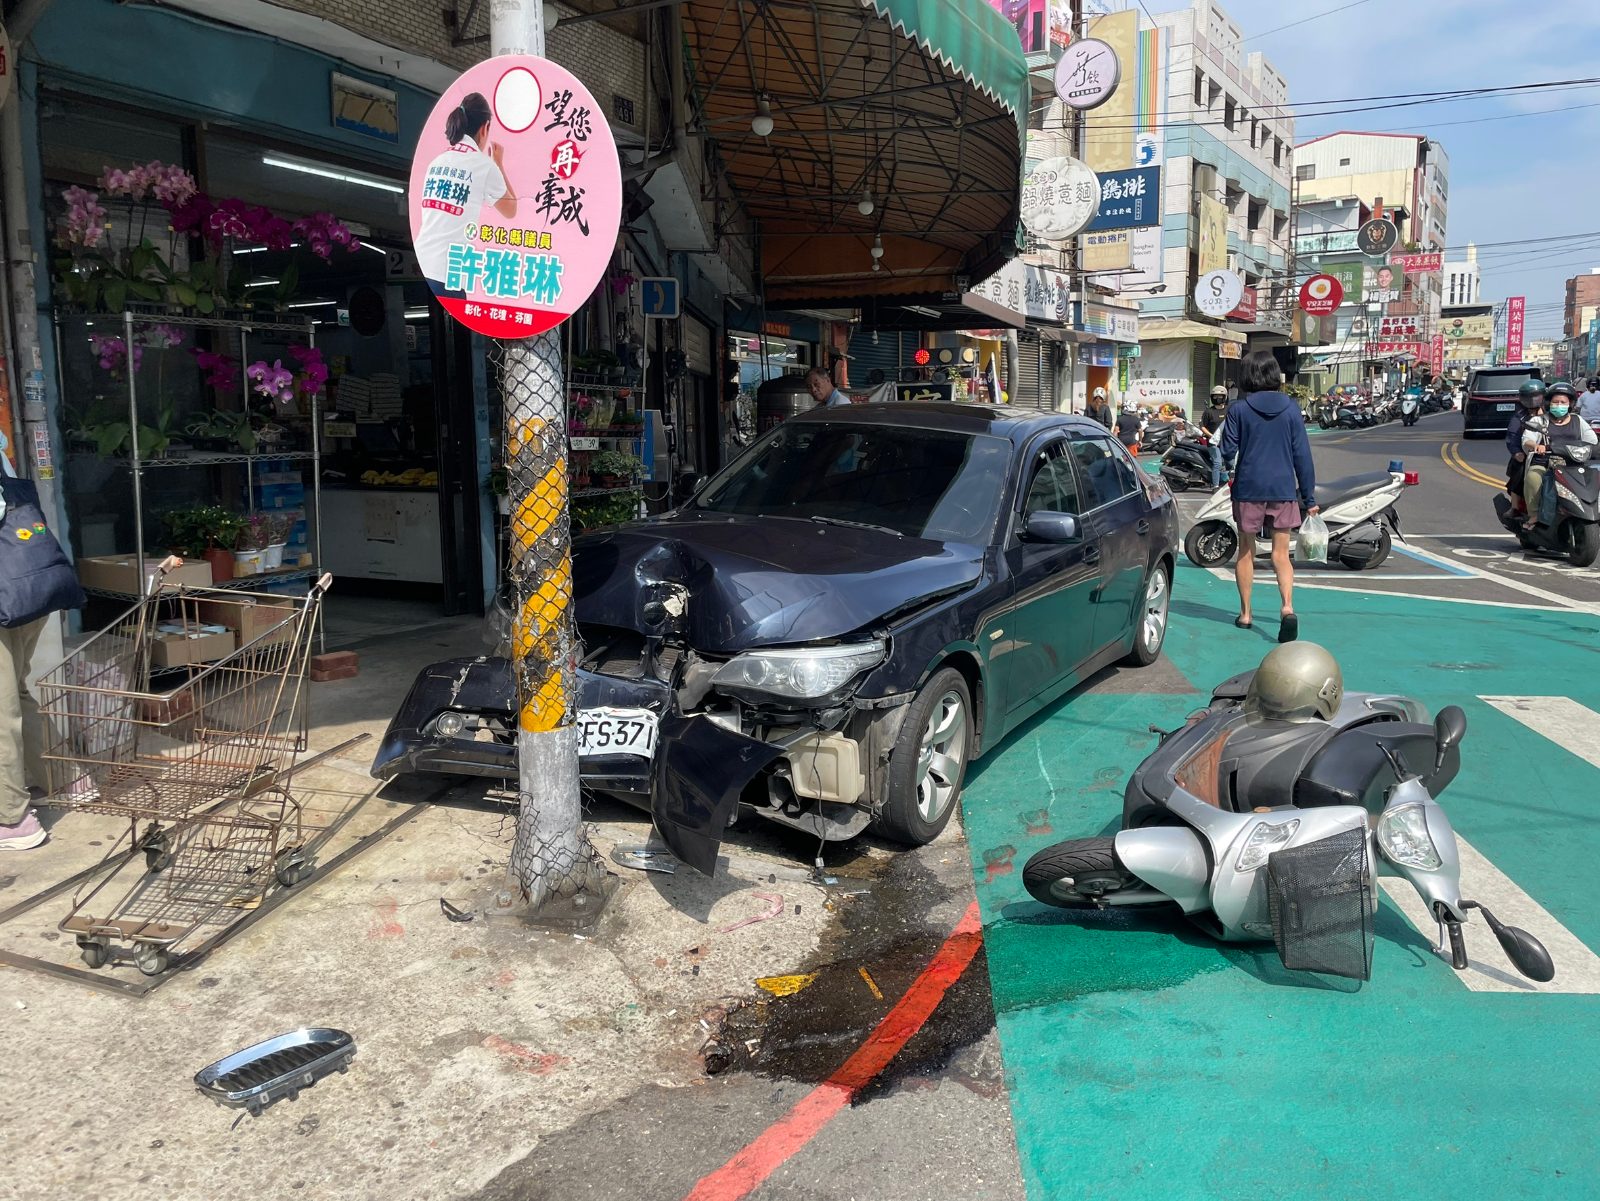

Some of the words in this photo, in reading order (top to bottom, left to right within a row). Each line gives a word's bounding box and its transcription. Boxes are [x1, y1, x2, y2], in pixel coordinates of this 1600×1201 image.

[544, 89, 592, 141] 望您
[551, 142, 580, 175] 再
[424, 178, 470, 206] 許雅琳
[1022, 182, 1091, 209] 鍋燒意麵
[480, 226, 552, 250] 彰化縣議員
[446, 245, 563, 302] 許雅琳
